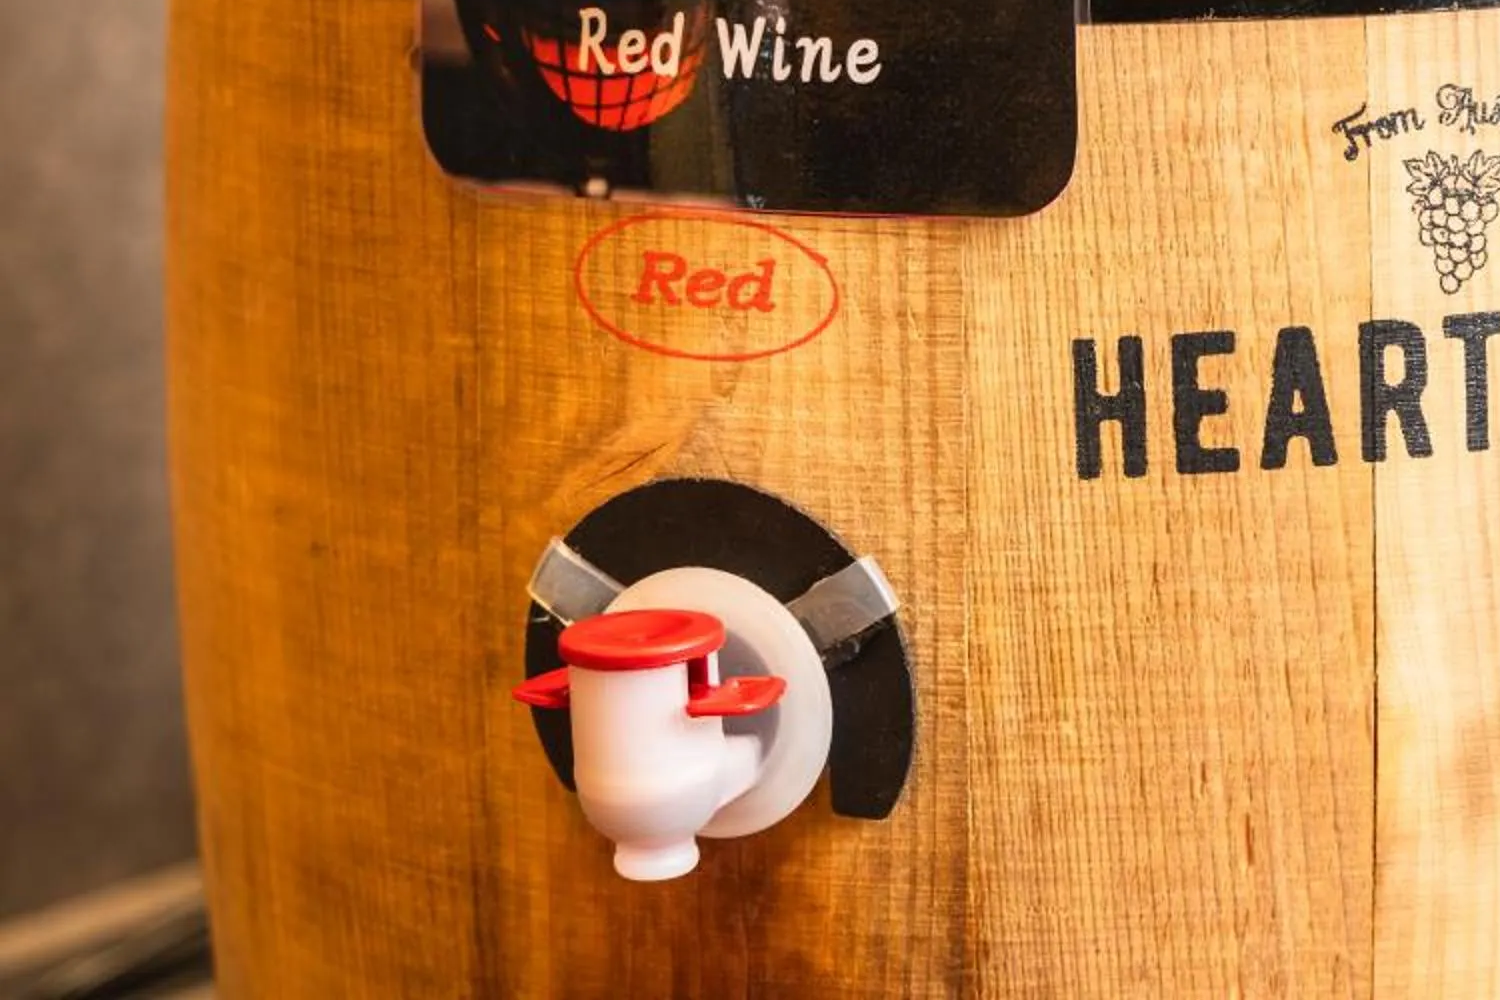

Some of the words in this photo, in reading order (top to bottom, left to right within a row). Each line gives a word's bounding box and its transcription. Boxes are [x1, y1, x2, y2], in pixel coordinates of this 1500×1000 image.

[578, 7, 685, 77] Red
[715, 17, 882, 84] Wine
[1331, 102, 1426, 161] From
[630, 250, 777, 313] Red
